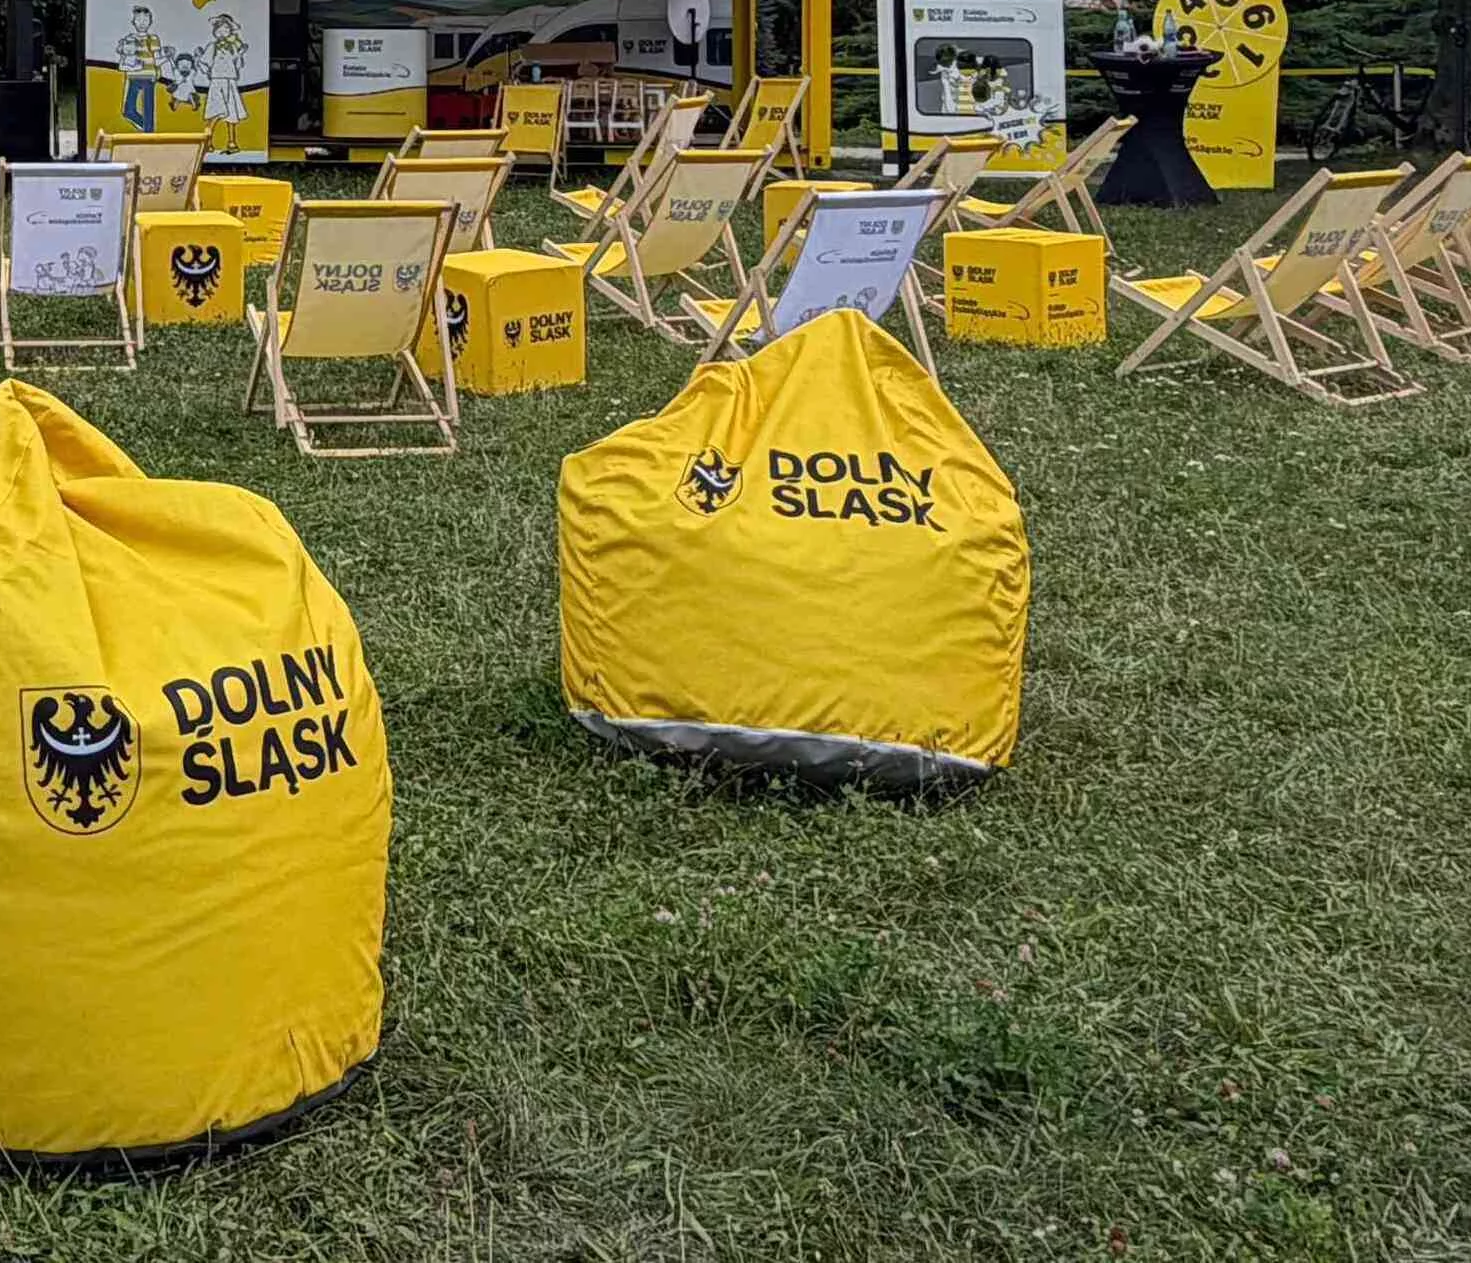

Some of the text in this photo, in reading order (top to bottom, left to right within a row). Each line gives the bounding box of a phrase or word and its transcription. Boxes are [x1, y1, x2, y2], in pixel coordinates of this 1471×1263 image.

[1242, 4, 1276, 30] 6
[1236, 42, 1265, 68] 1
[529, 311, 574, 330] DOLNY
[529, 325, 572, 344] ŚLĄSK
[768, 449, 934, 498] DOLNY
[162, 644, 347, 736] DOLNY
[180, 707, 360, 807] ŚLĄSK
